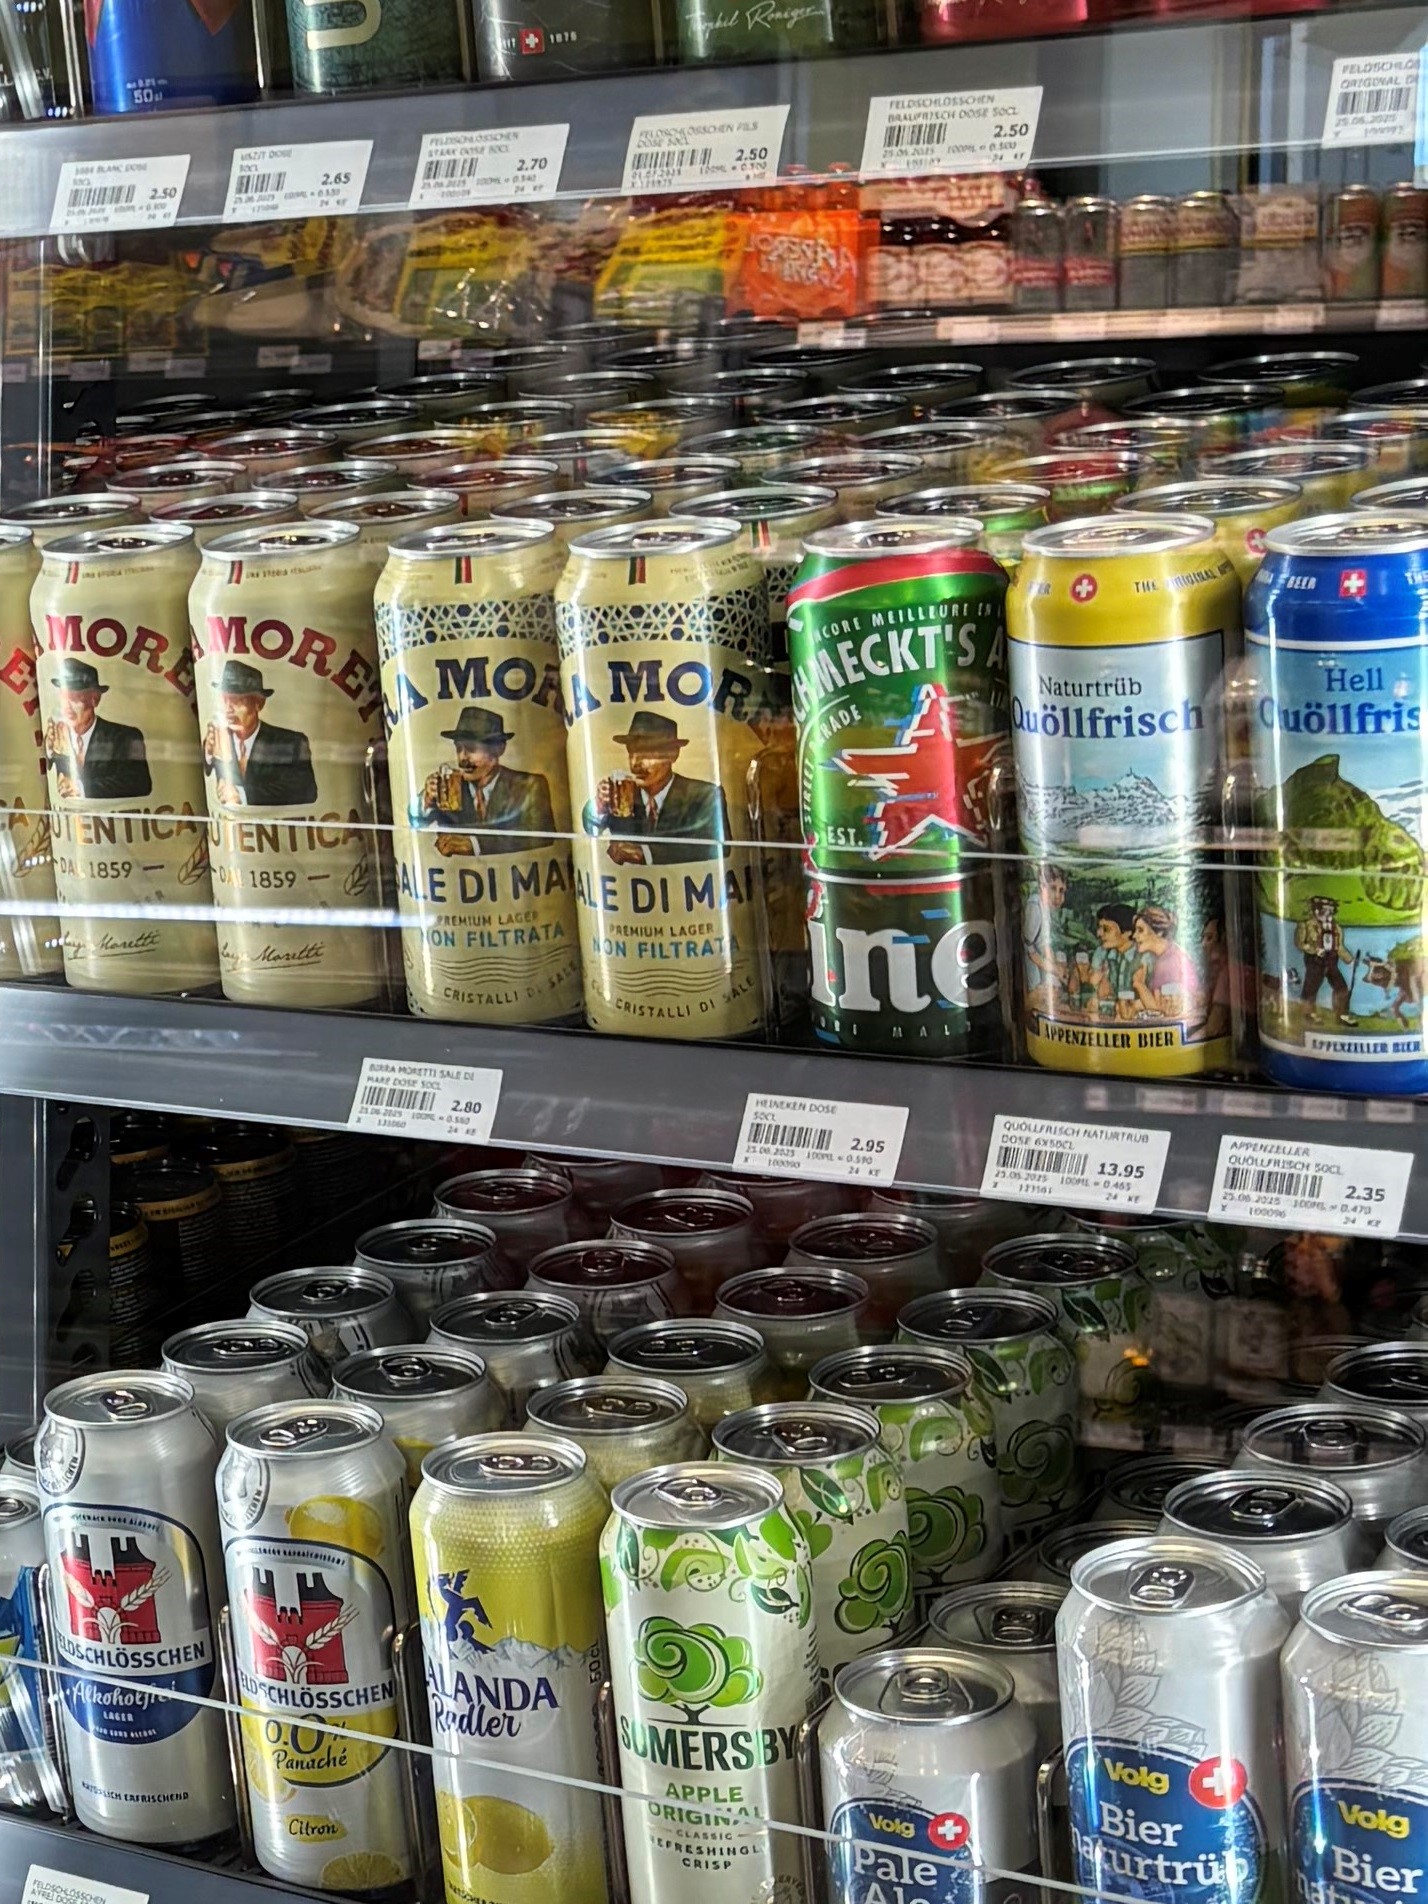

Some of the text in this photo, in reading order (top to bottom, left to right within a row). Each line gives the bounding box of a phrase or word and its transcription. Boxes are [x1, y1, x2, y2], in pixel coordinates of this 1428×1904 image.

[992, 123, 1030, 139] 2.50
[516, 156, 548, 173] 2.70
[735, 146, 769, 163] 2.50
[321, 172, 352, 187] 2.65
[149, 186, 178, 201] 2.50
[871, 603, 969, 628] MEILLEURE
[1038, 675, 1143, 697] Naturtrüb
[1325, 668, 1384, 694] Hell
[1011, 702, 1205, 739] Quöllfrisch
[827, 826, 863, 846] EST.
[89, 860, 133, 879] 1859
[248, 869, 297, 888] 1859
[458, 869, 497, 905] DI
[631, 878, 669, 914] DI
[436, 910, 538, 927] PREMIUM LAGER
[466, 923, 564, 950] FILTRATA
[609, 922, 715, 939] PREMIUM LAGER
[592, 935, 741, 960] NON FILTRATA
[443, 985, 519, 1007] CRISTALLI
[616, 998, 716, 1020] CRISTALLI DI
[1137, 1027, 1175, 1049] BIER
[452, 1100, 482, 1115] 2.80
[809, 1104, 838, 1116] DOSE
[849, 1137, 886, 1154] 2.95
[1229, 1140, 1311, 1158] APPENZELLER
[1097, 1161, 1145, 1180] 13.95
[1314, 1161, 1344, 1176] 50CL
[1344, 1184, 1386, 1202] 2.35
[103, 1711, 134, 1722] LAGER
[620, 1715, 798, 1773] SOMERSBY
[272, 1747, 348, 1772] Panaché
[1103, 1758, 1170, 1796] Volg
[665, 1781, 745, 1805] APPLE
[288, 1817, 339, 1836] Citron
[870, 1812, 916, 1839] Volg
[1099, 1801, 1183, 1849] Bier
[1339, 1802, 1410, 1839] Volg
[676, 1828, 734, 1842] CLASSIC
[680, 1856, 733, 1871] CRISP
[851, 1845, 939, 1888] Pale
[1071, 1827, 1249, 1886] naturtrüb
[1331, 1846, 1423, 1894] Bier
